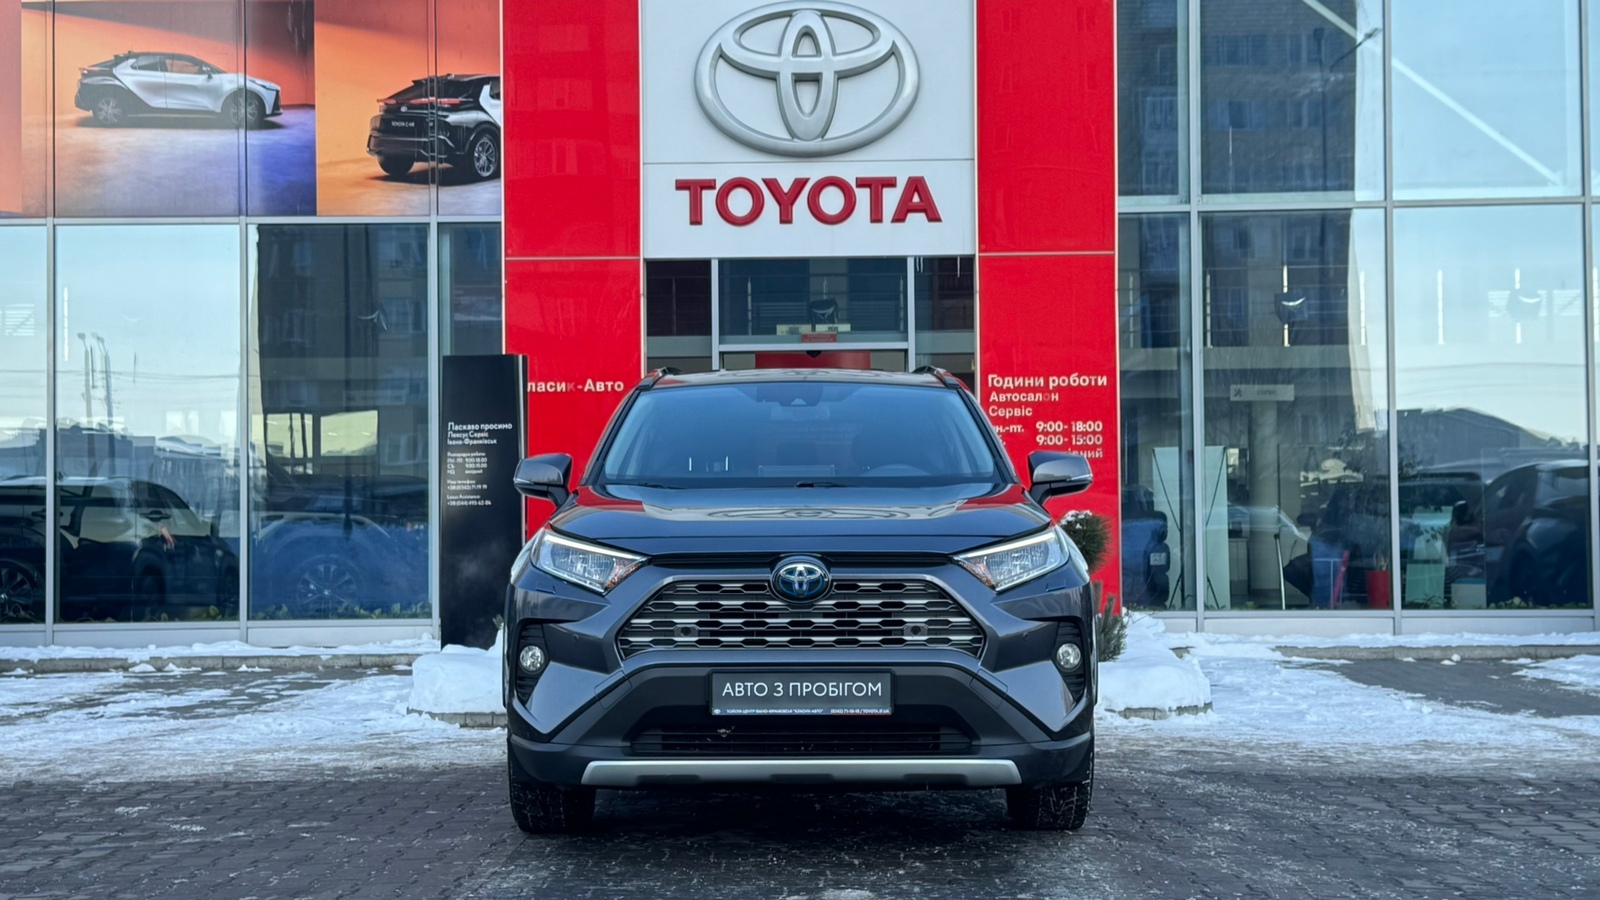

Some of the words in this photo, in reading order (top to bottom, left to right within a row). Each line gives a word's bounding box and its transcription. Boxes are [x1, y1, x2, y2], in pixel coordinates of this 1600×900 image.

[675, 176, 942, 226] TOYOTA
[527, 379, 624, 393] ласик-Авто
[988, 374, 1044, 388] Години
[1049, 373, 1107, 389] роботи
[989, 391, 1059, 402] Автосалон
[989, 405, 1033, 419] Сервіс
[448, 421, 480, 431] Ласкаво
[480, 423, 513, 432] просимо
[993, 424, 1025, 433] н.-пт.
[722, 682, 768, 697] АВТО
[773, 682, 784, 697] З
[789, 682, 882, 697] ПРОБІГОМ
